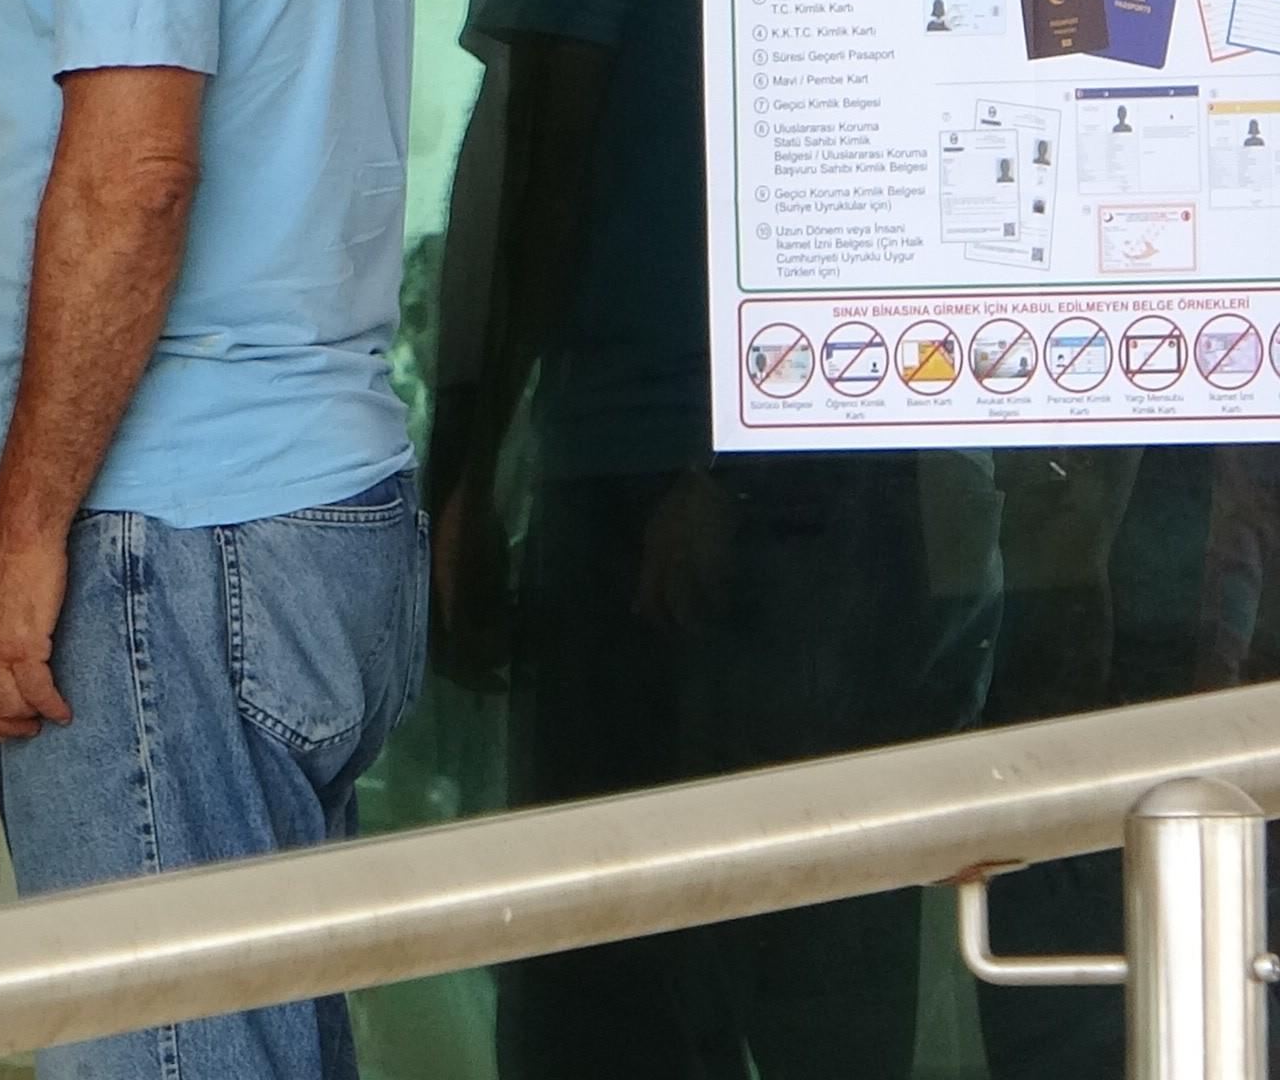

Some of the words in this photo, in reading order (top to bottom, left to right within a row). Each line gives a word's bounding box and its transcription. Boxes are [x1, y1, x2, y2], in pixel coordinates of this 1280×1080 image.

[795, 4, 825, 13] Kimlik
[829, 3, 853, 12] Kartı
[817, 27, 847, 36] Kimlik
[852, 27, 876, 35] Kartı
[773, 52, 805, 62] Süresi
[808, 51, 845, 64] Geçerli
[849, 50, 894, 61] Pasaport
[773, 76, 797, 86] Mavi
[807, 75, 843, 85] Pembe
[847, 74, 868, 84] Kart
[773, 99, 805, 112] Geçici
[809, 99, 838, 108] Kimlik
[843, 98, 881, 109] Belgesi
[774, 124, 835, 134] Uluslararası
[839, 122, 879, 132] Koruma
[774, 137, 801, 147] Statü
[804, 136, 836, 147] Sahibi
[840, 136, 870, 145] Kimlik
[774, 151, 812, 163] Belgesi
[822, 150, 884, 160] Uluslararası
[887, 148, 927, 158] Koruma
[774, 165, 817, 177] Başvuru
[820, 163, 852, 174] Sahibi
[856, 164, 885, 172] Kimlik
[890, 162, 927, 174] Belgesi
[775, 188, 806, 201] Geçici
[810, 188, 850, 198] Koruma
[853, 187, 883, 197] Kimlik
[888, 186, 925, 198] Belgesi
[775, 200, 811, 214] (Suriye
[815, 200, 866, 214] Uyruklular
[870, 200, 891, 213] için)
[776, 226, 803, 236] Uzun
[806, 225, 843, 236] Dönem
[846, 226, 871, 237] veya
[875, 222, 905, 233] İnsani
[776, 238, 810, 250] İkamet
[814, 237, 832, 249] İzni
[835, 238, 873, 251] Belgesi
[877, 237, 898, 250] (Çin
[901, 237, 923, 247] Halk
[776, 253, 838, 264] Cumhuriyeti
[841, 252, 880, 264] Uyruklu
[884, 251, 914, 263] Uygur
[777, 267, 815, 277] Türkleri
[818, 267, 840, 279] için)
[833, 307, 868, 317] SINAV
[872, 304, 930, 317] BİNASINA
[933, 304, 980, 315] GİRMEK
[984, 302, 1007, 316] İÇİN
[1012, 303, 1054, 313] KABUL
[1058, 300, 1128, 312] EDİLMEYEN
[1133, 300, 1173, 311] BELGE
[1178, 297, 1249, 310] ÖRNEKLERİ
